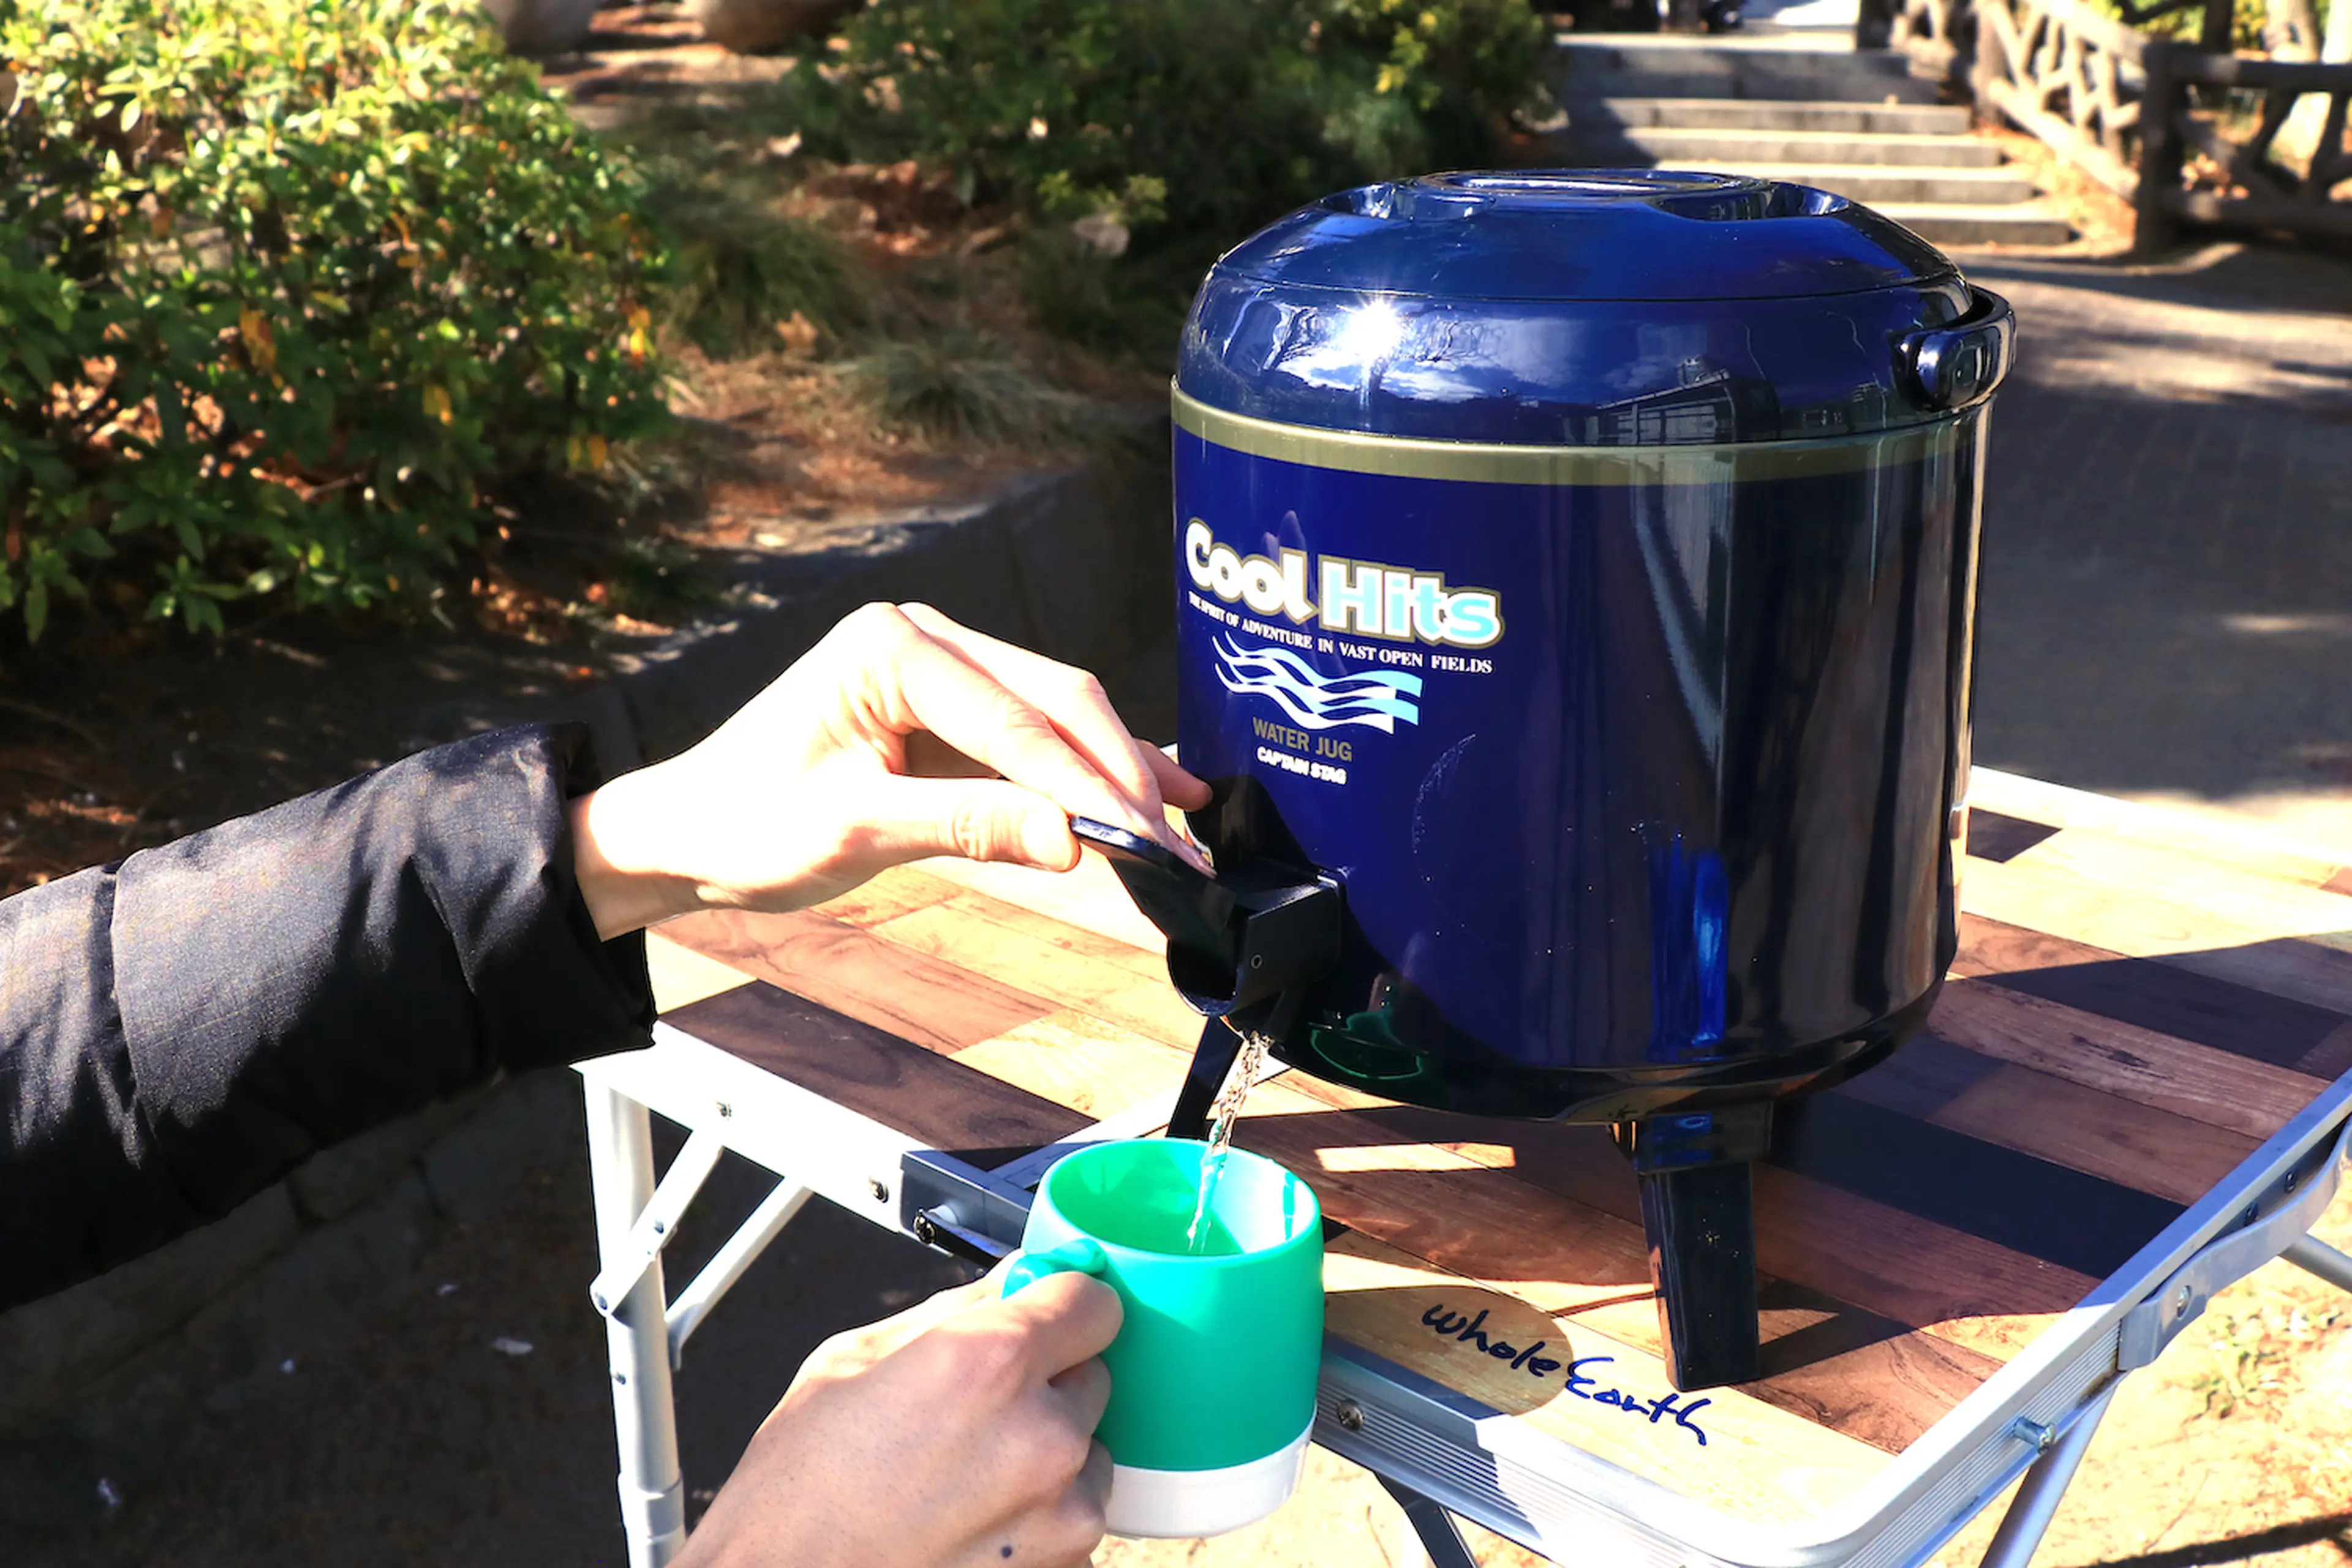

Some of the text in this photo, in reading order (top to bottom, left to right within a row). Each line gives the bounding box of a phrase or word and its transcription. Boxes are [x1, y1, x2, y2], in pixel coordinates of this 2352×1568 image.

[1185, 518, 1504, 649] Cool Hits
[1201, 598, 1225, 622] SPIRIT
[1226, 612, 1240, 627] OF
[1242, 618, 1313, 649] ADVENTURE
[1317, 638, 1334, 654] IN
[1339, 642, 1377, 661] VAST
[1379, 649, 1423, 667] OPEN
[1431, 655, 1493, 674] FIELDS
[1253, 716, 1352, 763] WATER JUG
[1257, 746, 1348, 785] CAPTAIN STAG
